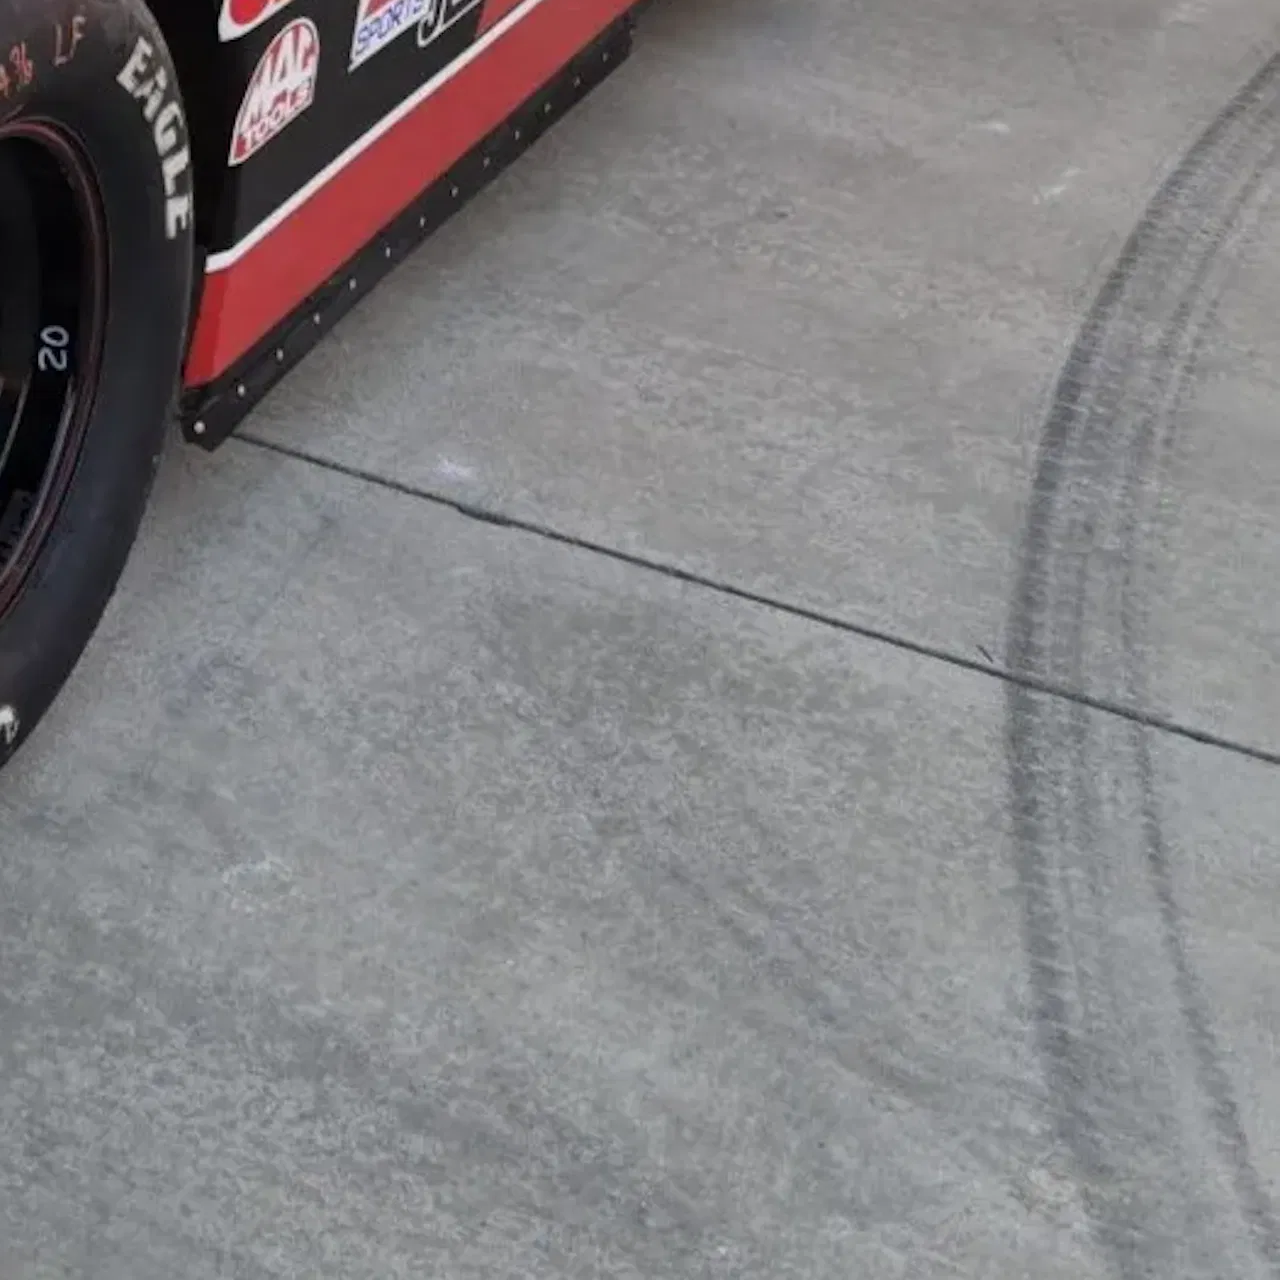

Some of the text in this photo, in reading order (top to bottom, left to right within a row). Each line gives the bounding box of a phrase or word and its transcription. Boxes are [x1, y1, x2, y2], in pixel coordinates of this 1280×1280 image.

[51, 15, 89, 68] LF
[115, 35, 196, 240] EAGLE
[37, 324, 70, 372] 20
